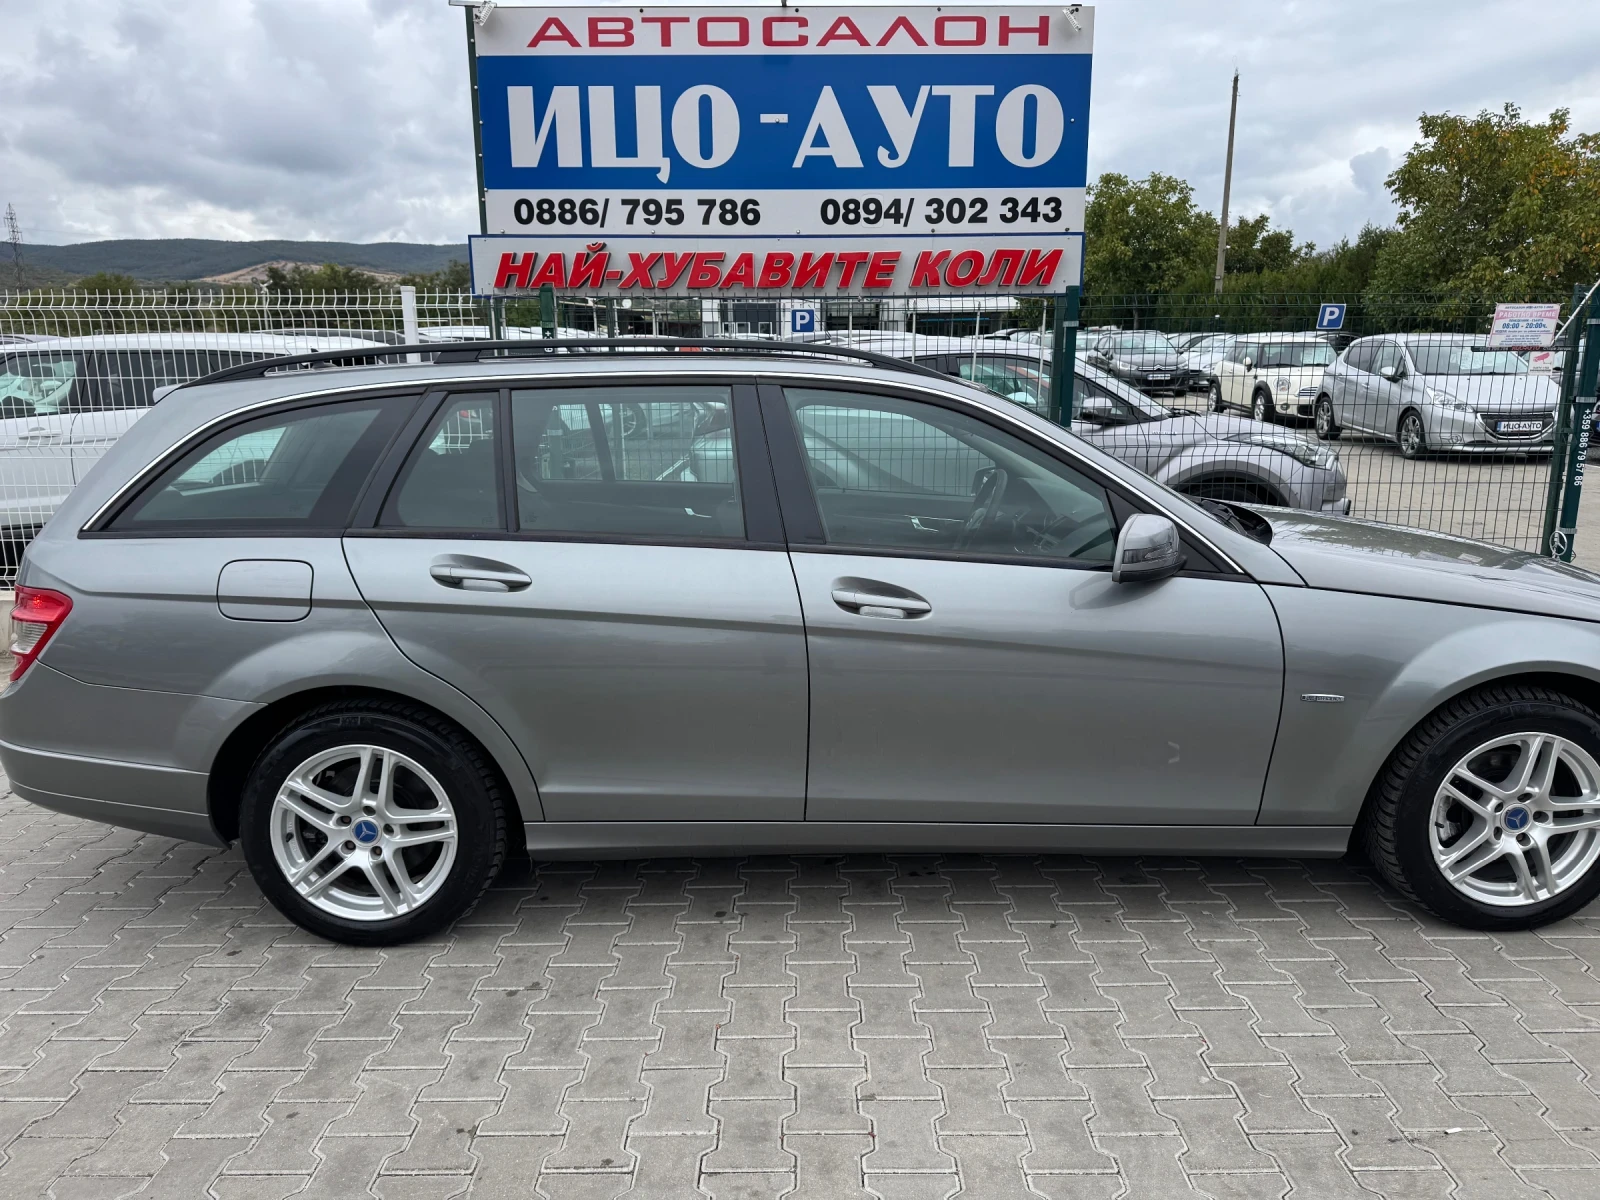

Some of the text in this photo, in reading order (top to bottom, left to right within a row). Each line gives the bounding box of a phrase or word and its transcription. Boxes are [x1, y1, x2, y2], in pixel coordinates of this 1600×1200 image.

[528, 16, 1049, 48] АВТОСАЛОН
[513, 198, 761, 228] 0886/ 795 786
[820, 196, 1062, 228] 0894/ 302 343
[493, 241, 1064, 290] НАЙ-ХУБАВИТЕ КОЛИ
[1574, 408, 1592, 486] +359 886 79 57 86
